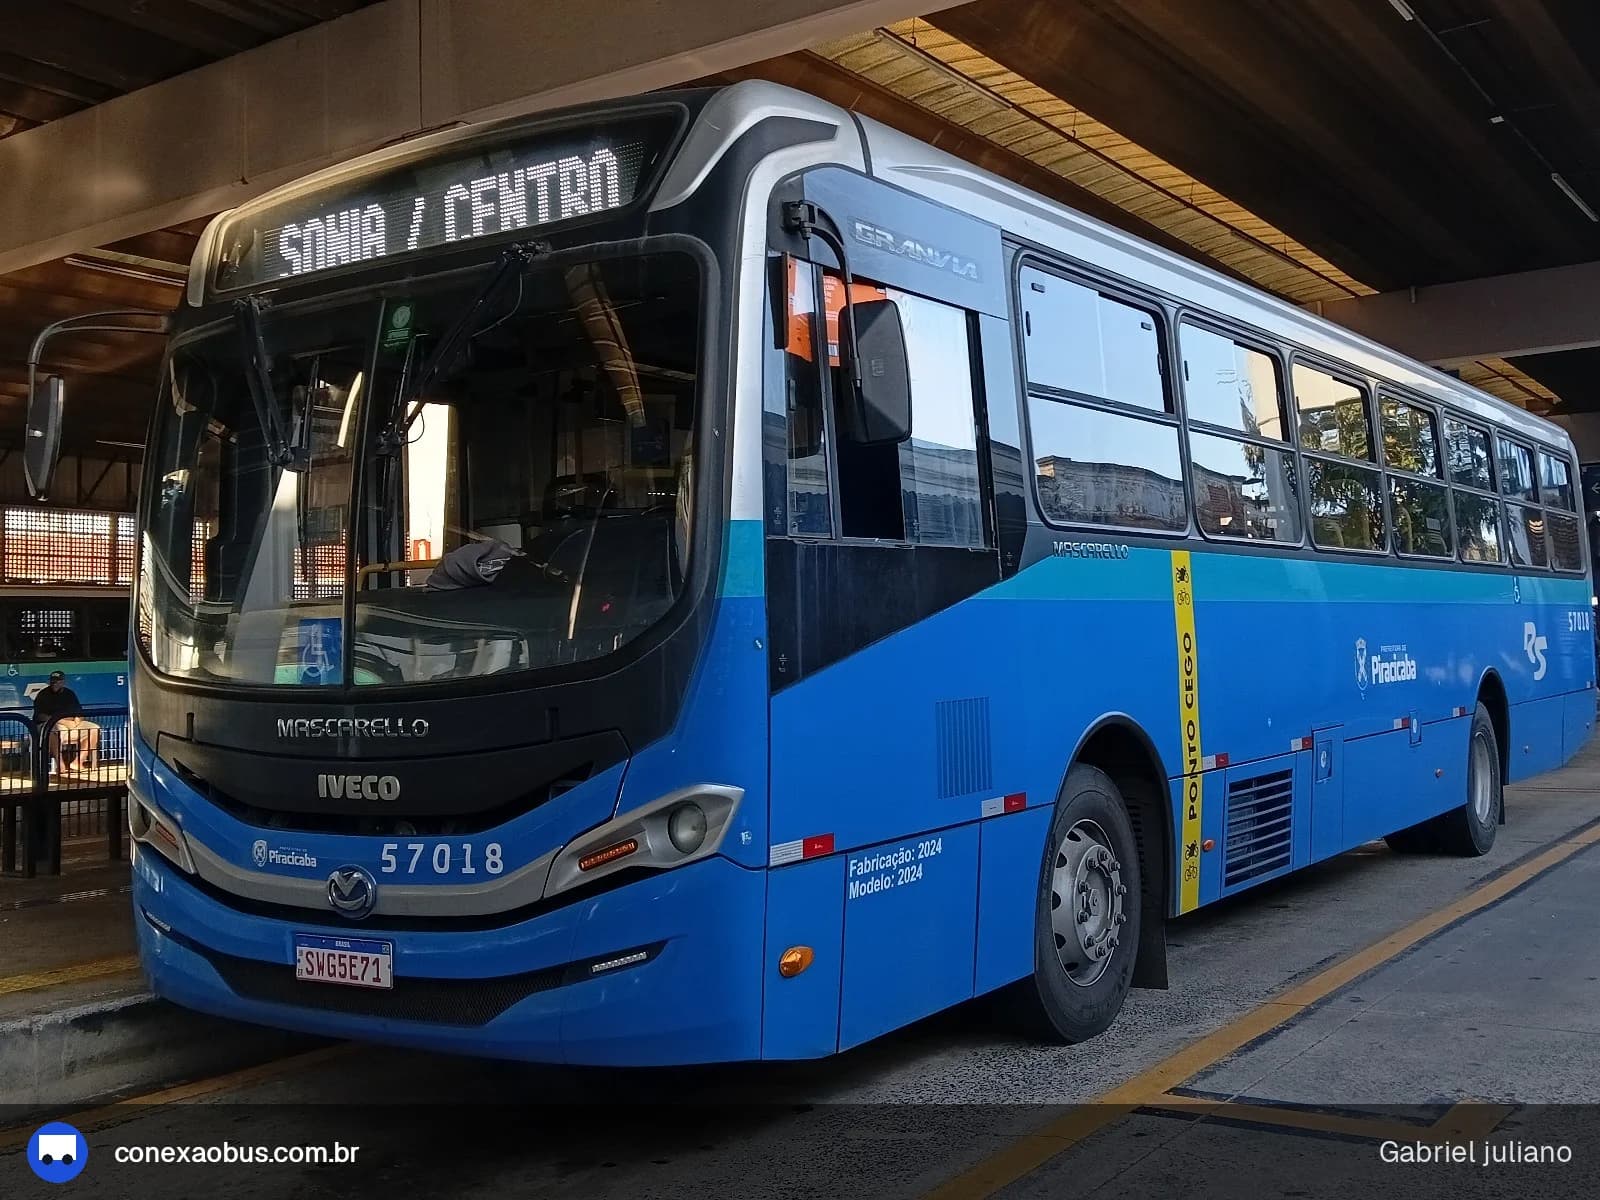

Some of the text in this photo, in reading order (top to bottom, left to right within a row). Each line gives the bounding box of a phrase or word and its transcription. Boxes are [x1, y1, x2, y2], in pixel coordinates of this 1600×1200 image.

[444, 148, 620, 243] CENTRO
[1052, 541, 1129, 560] MASCARELLO
[1568, 611, 1590, 632] 57018
[1371, 653, 1417, 685] Piracicaba
[277, 718, 429, 738] MASCARELLO
[1182, 632, 1198, 821] PONTO CEGO
[317, 774, 401, 801] IVECO
[268, 850, 317, 868] Piracicaba
[380, 843, 504, 875] 57018
[849, 837, 942, 878] Fabricação: 2024
[848, 862, 923, 900] Modelo: 2024
[305, 950, 382, 983] SWG5E71
